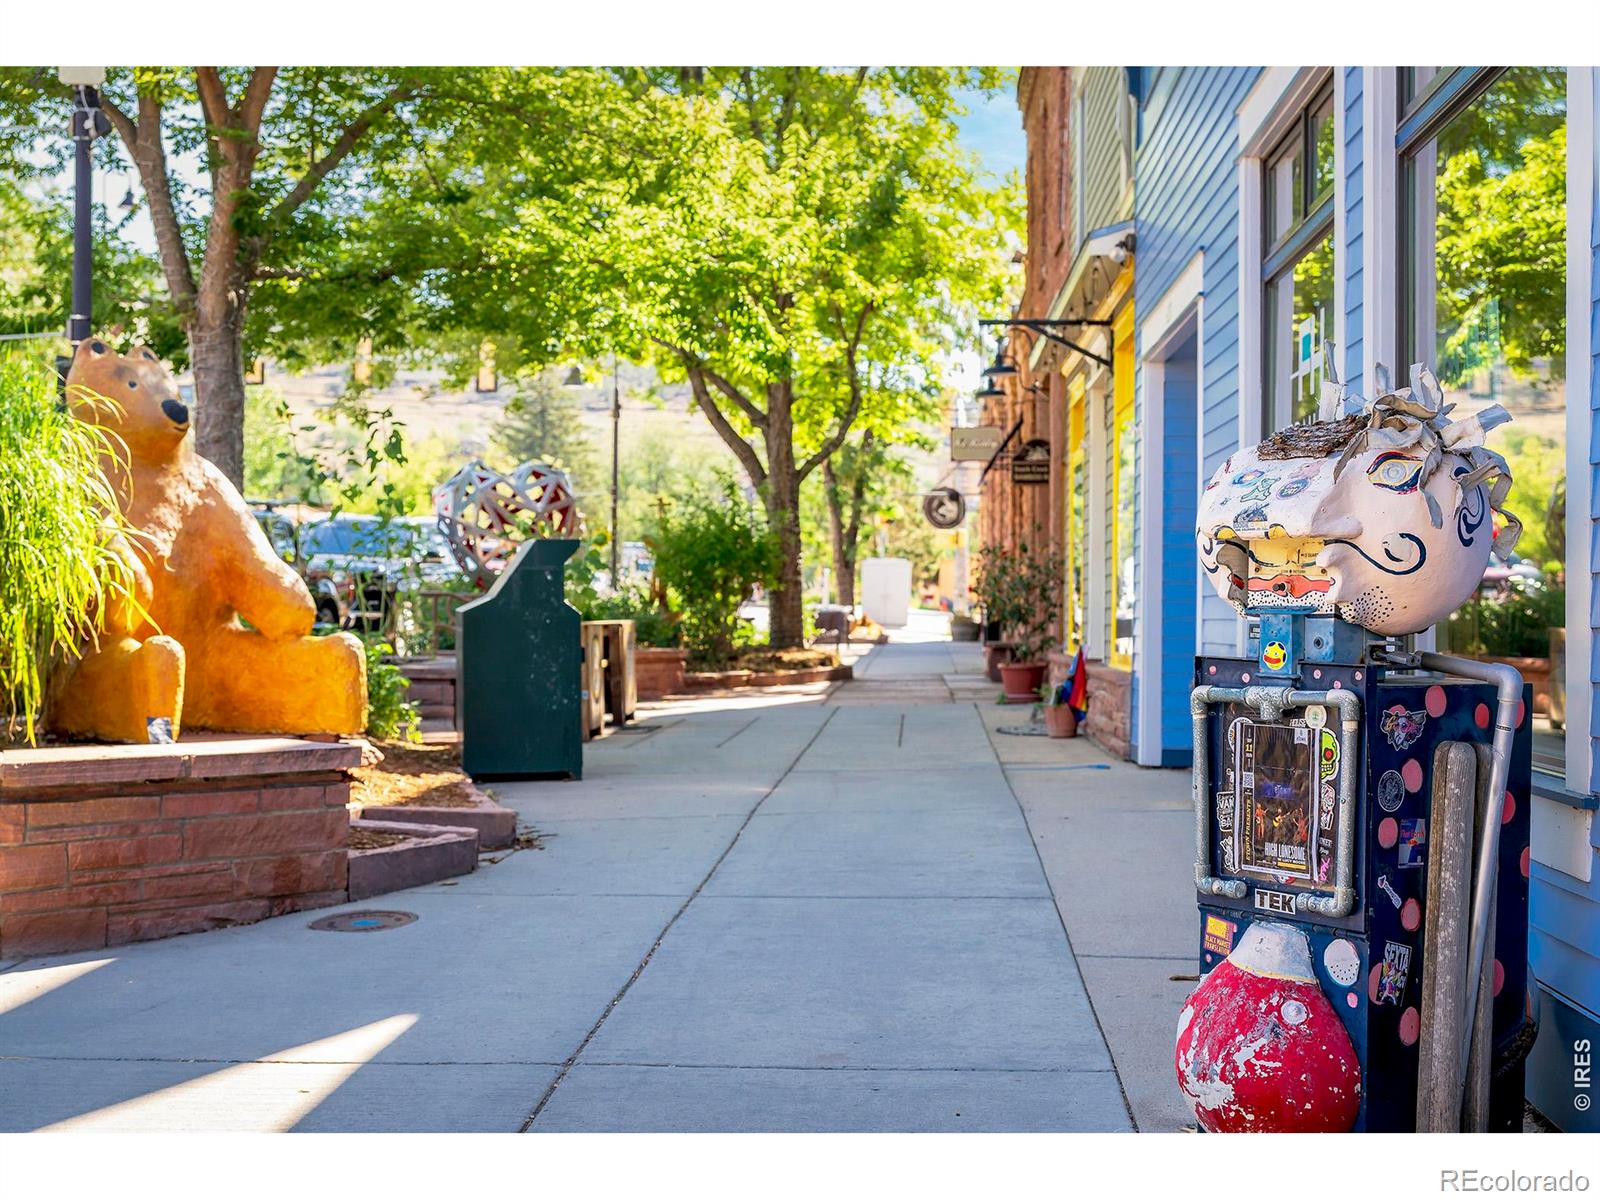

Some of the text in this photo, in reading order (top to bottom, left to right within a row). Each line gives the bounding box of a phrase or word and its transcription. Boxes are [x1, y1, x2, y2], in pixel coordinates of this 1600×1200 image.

[1264, 842, 1278, 857] HIGH
[1278, 844, 1306, 861] LONESOME
[1256, 890, 1294, 913] TEK
[1384, 942, 1410, 973] SEXTA
